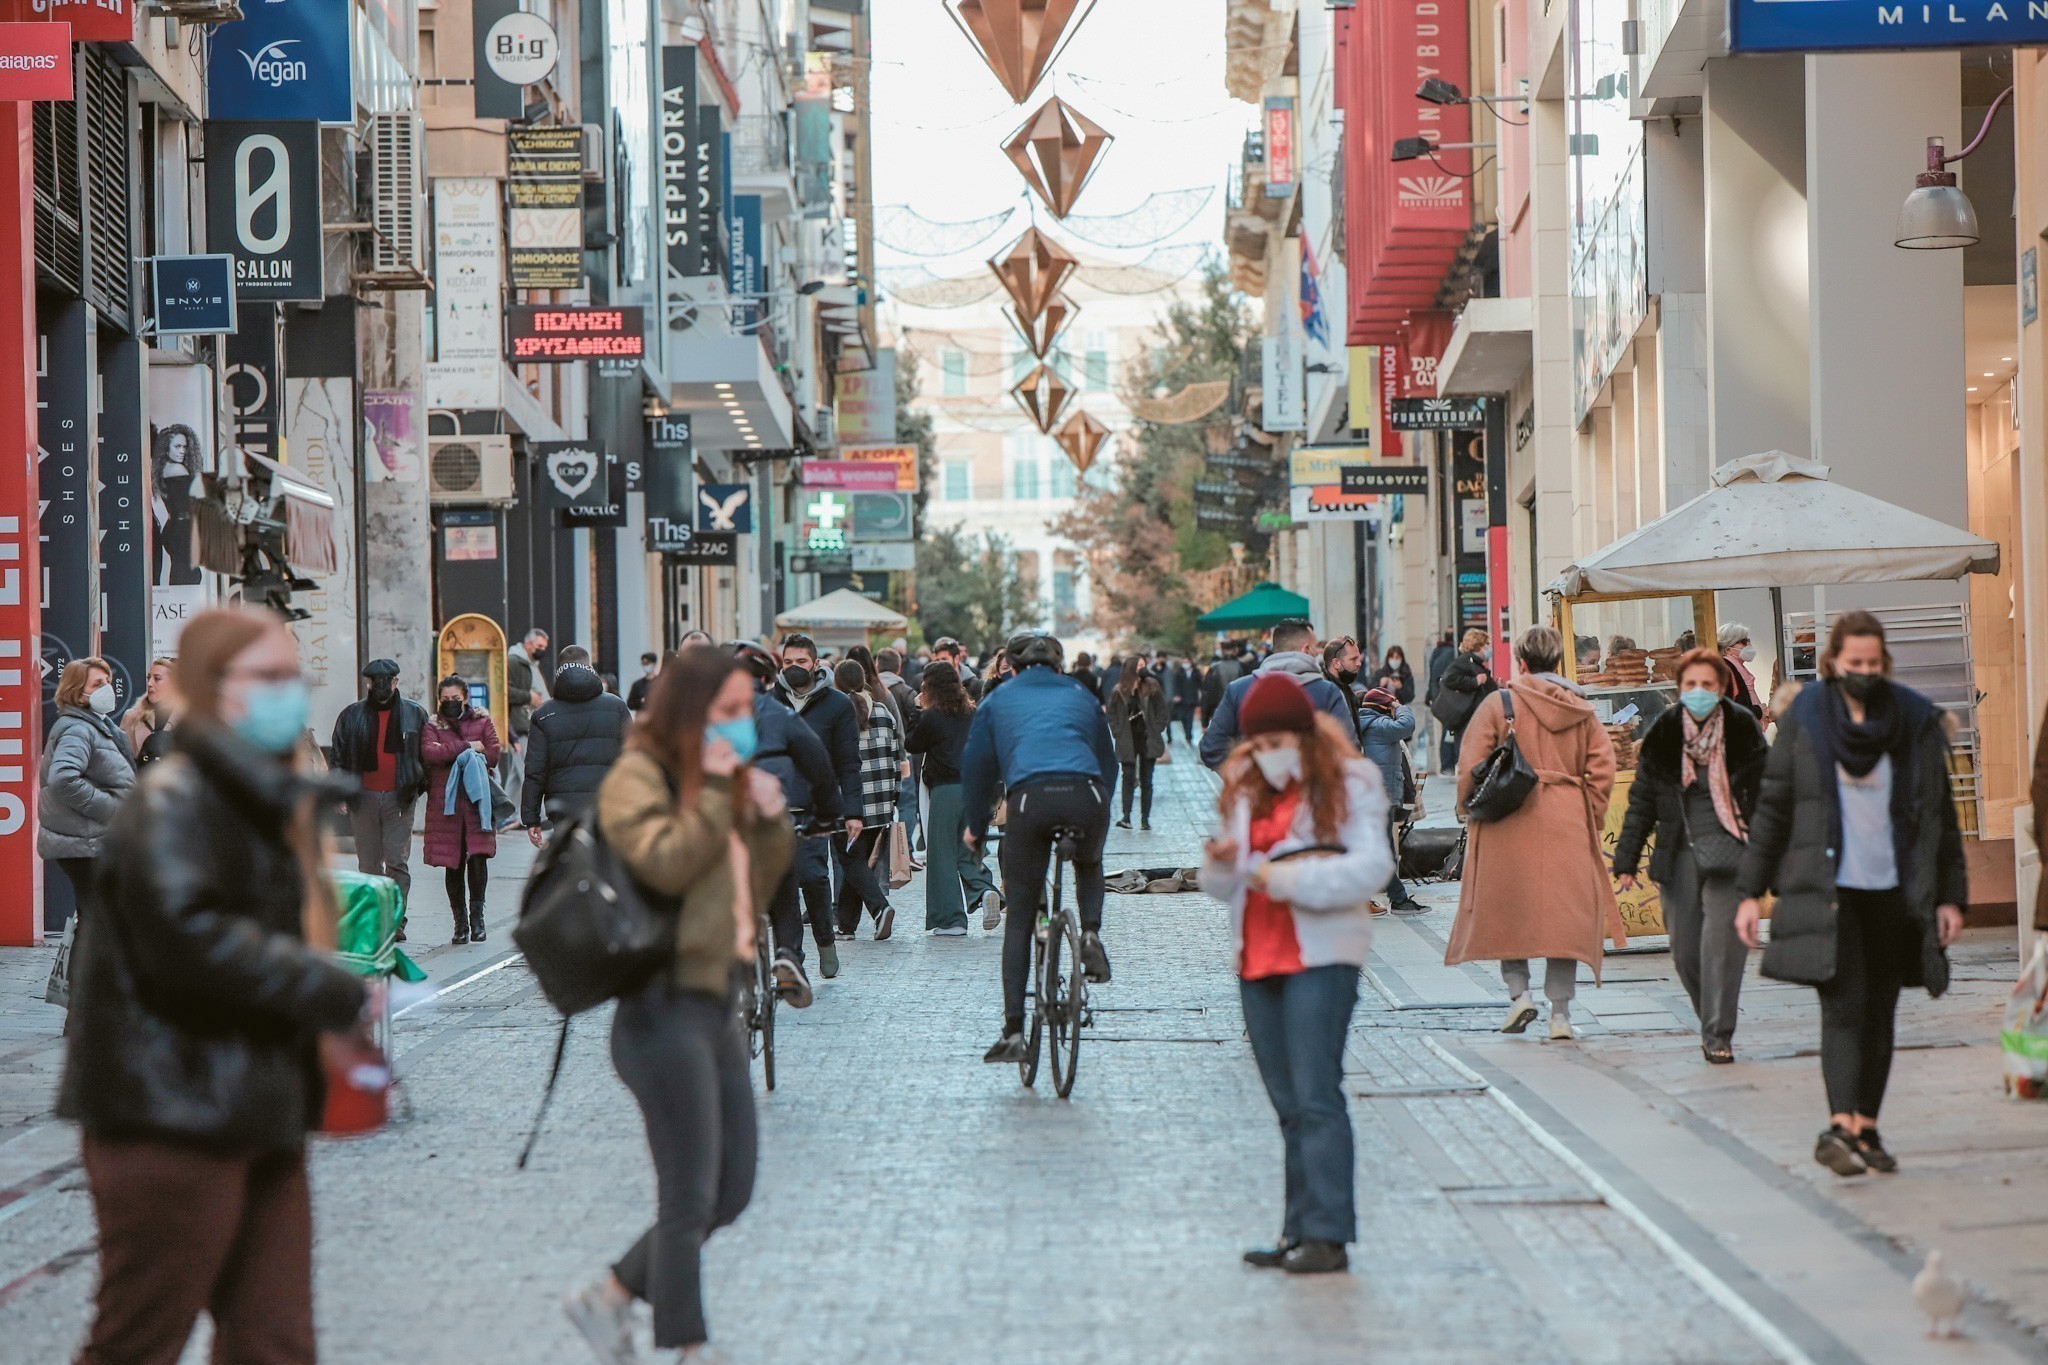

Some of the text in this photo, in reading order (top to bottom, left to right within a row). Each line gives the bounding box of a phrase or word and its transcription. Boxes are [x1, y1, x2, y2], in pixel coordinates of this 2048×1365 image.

[498, 34, 543, 59] Big
[237, 39, 307, 88] Vegan
[663, 85, 688, 247] SEPHORA
[512, 254, 579, 265] ΗΜΙΟΡΟΦΟΣ
[236, 260, 292, 279] SALON
[165, 296, 222, 306] ENVIE
[534, 312, 622, 331] ΠΩΛΗΣΗ
[513, 336, 642, 355] ΧΡΥΣΑΦΙΚΩΝ
[1393, 411, 1483, 423] FUNKYBUDDHA
[647, 417, 689, 440] Ths
[851, 449, 906, 460] ΑΓΟΡΑ
[61, 418, 75, 525] SHOES
[804, 467, 894, 484] pink woman
[117, 453, 131, 552] SHOES
[648, 518, 691, 541] Ths
[701, 542, 728, 555] ZAC
[115, 678, 123, 698] 1972
